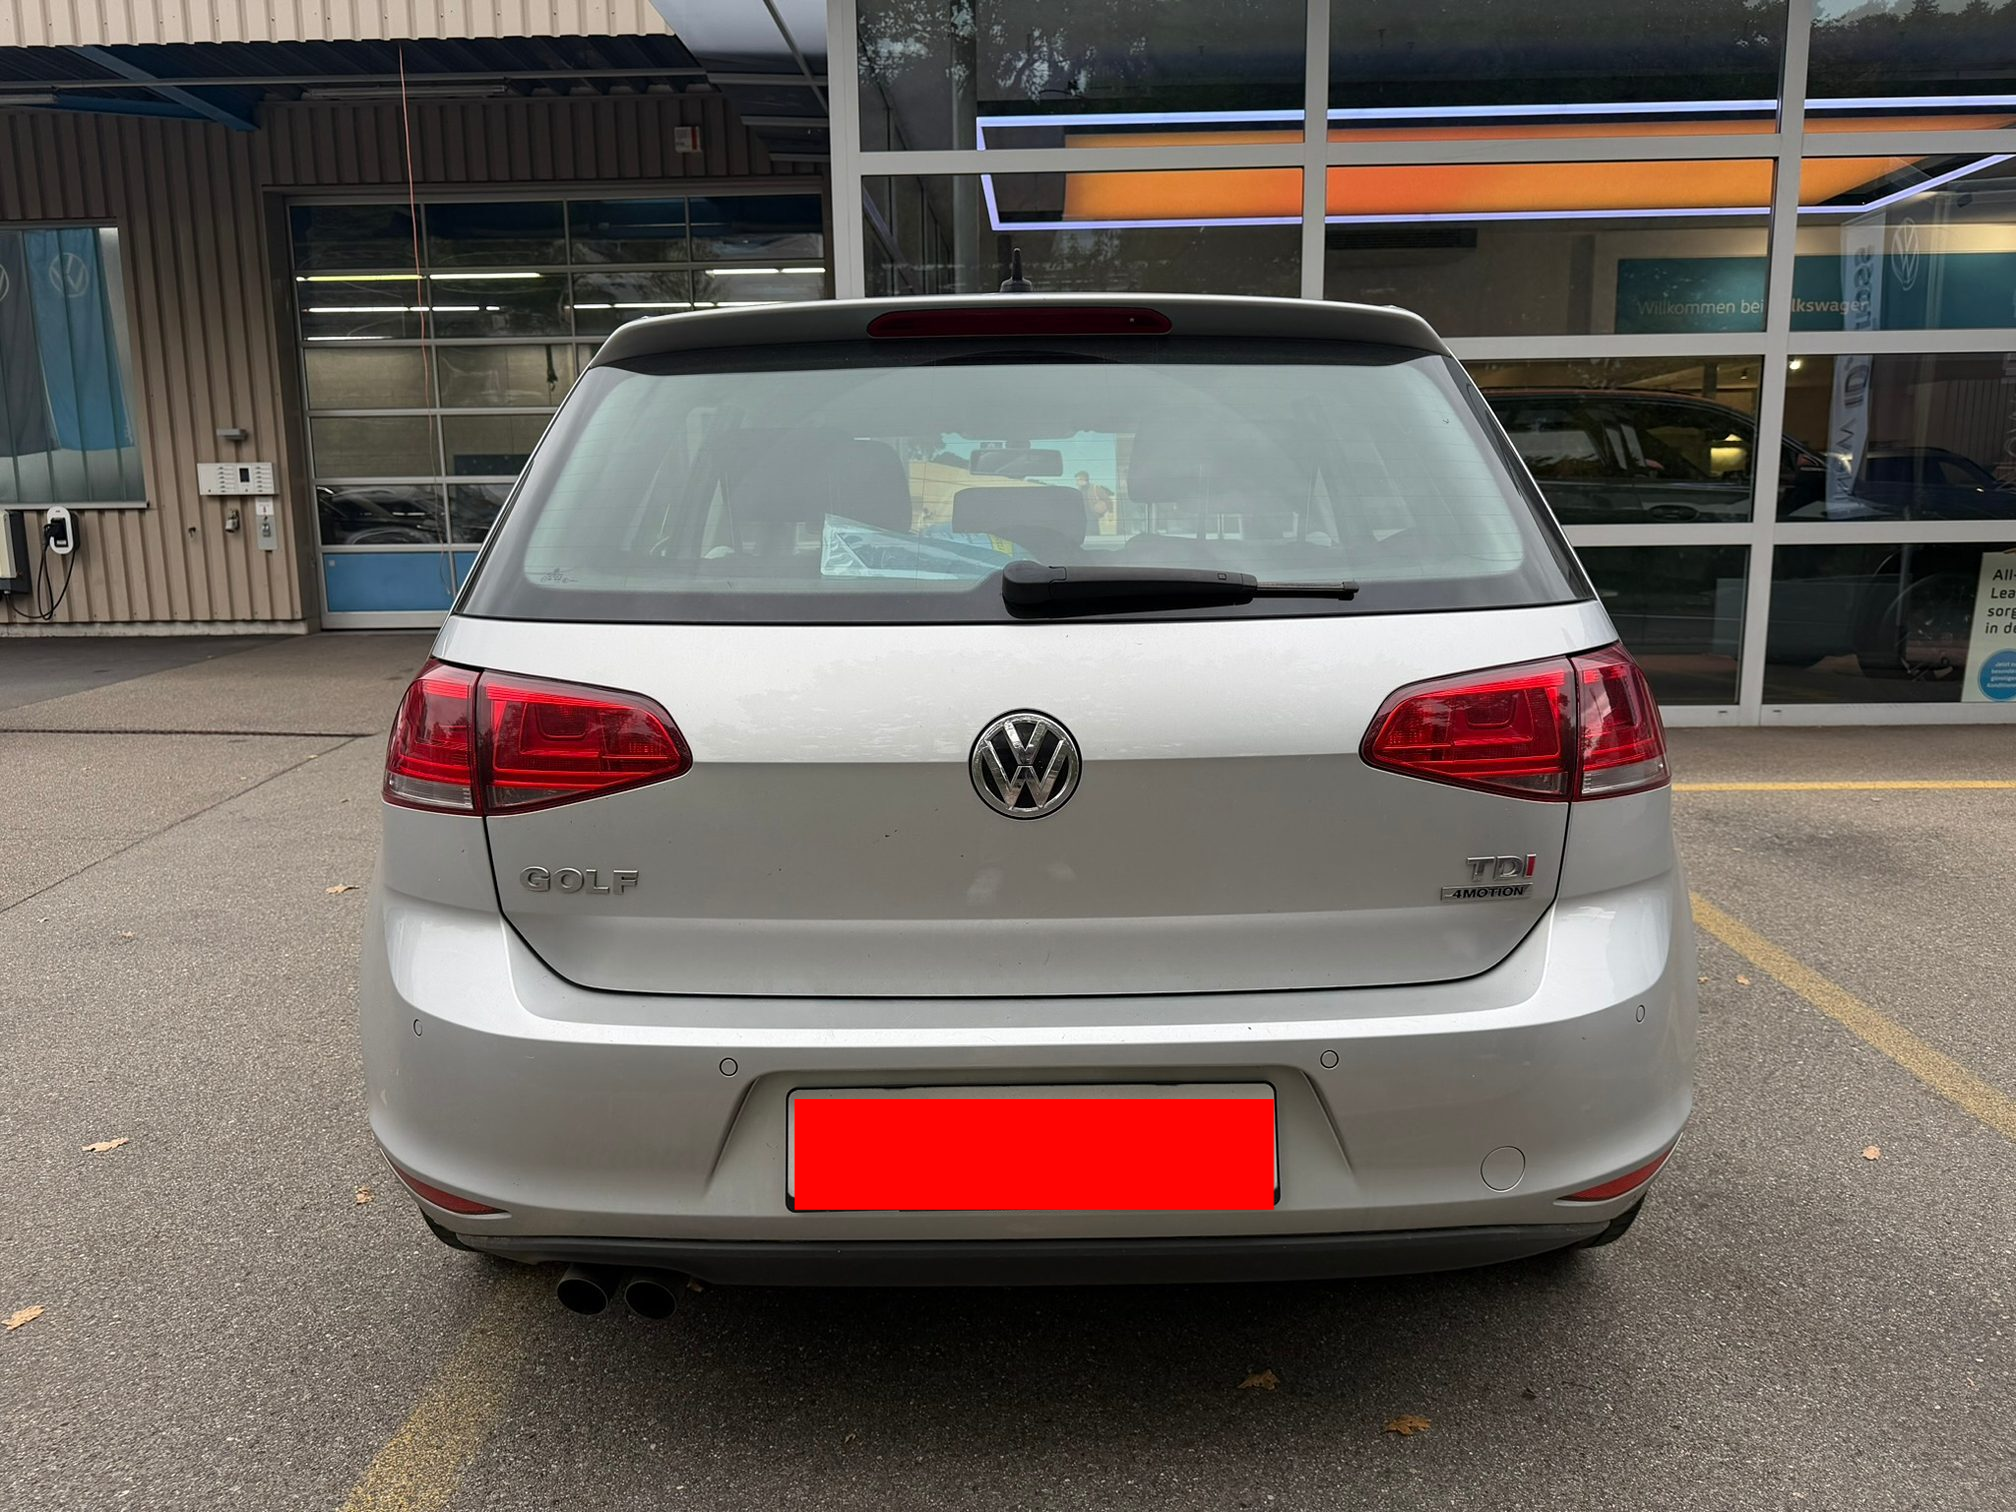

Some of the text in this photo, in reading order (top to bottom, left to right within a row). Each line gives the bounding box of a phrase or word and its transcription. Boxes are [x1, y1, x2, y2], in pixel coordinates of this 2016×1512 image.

[1638, 299, 1736, 315] Willkommen
[1740, 299, 1764, 314] bei
[1985, 622, 1999, 634] in
[1466, 853, 1537, 882] TDI
[519, 866, 640, 895] GOLF
[1451, 886, 1526, 900] 4MOTION
